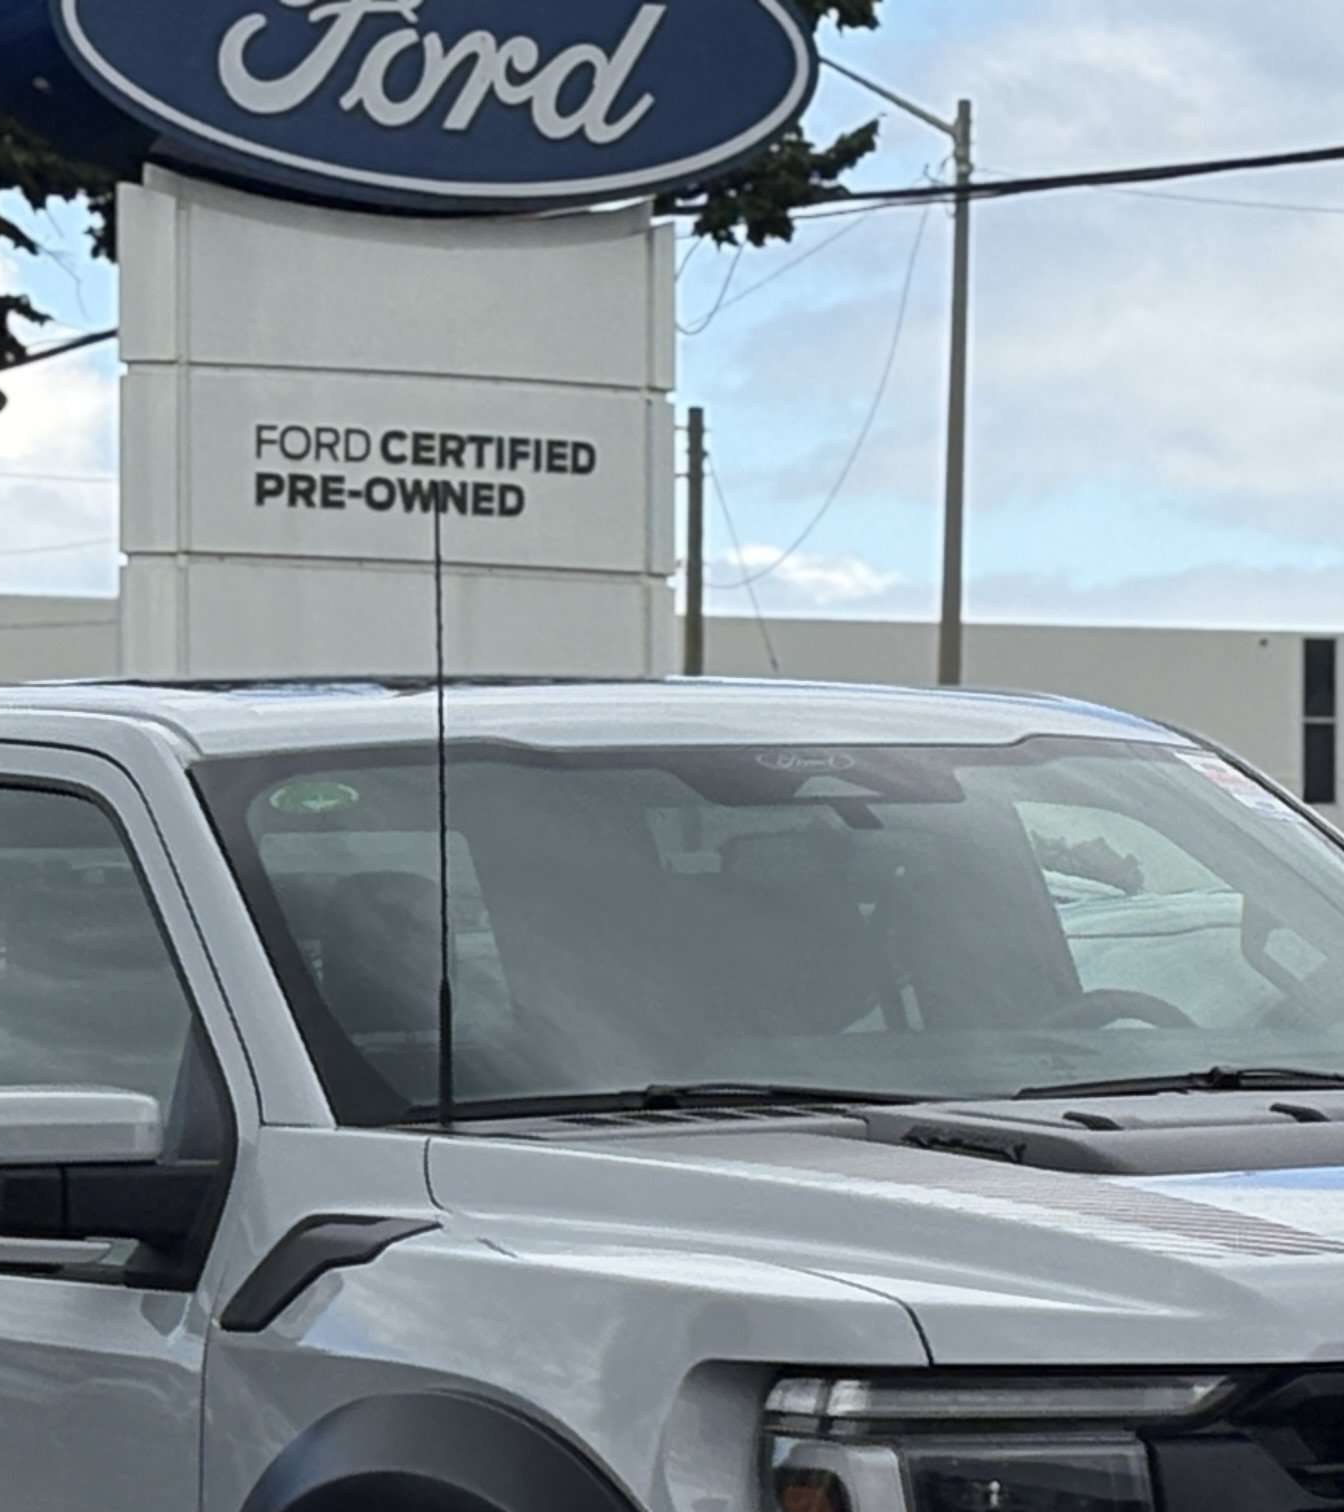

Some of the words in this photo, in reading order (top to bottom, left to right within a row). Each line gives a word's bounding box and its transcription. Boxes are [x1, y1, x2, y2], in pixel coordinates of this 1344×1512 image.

[218, 0, 667, 145] Ford
[254, 423, 372, 463] FORD
[379, 430, 597, 476] CERTIFIED
[254, 471, 526, 518] PRE-OWNED
